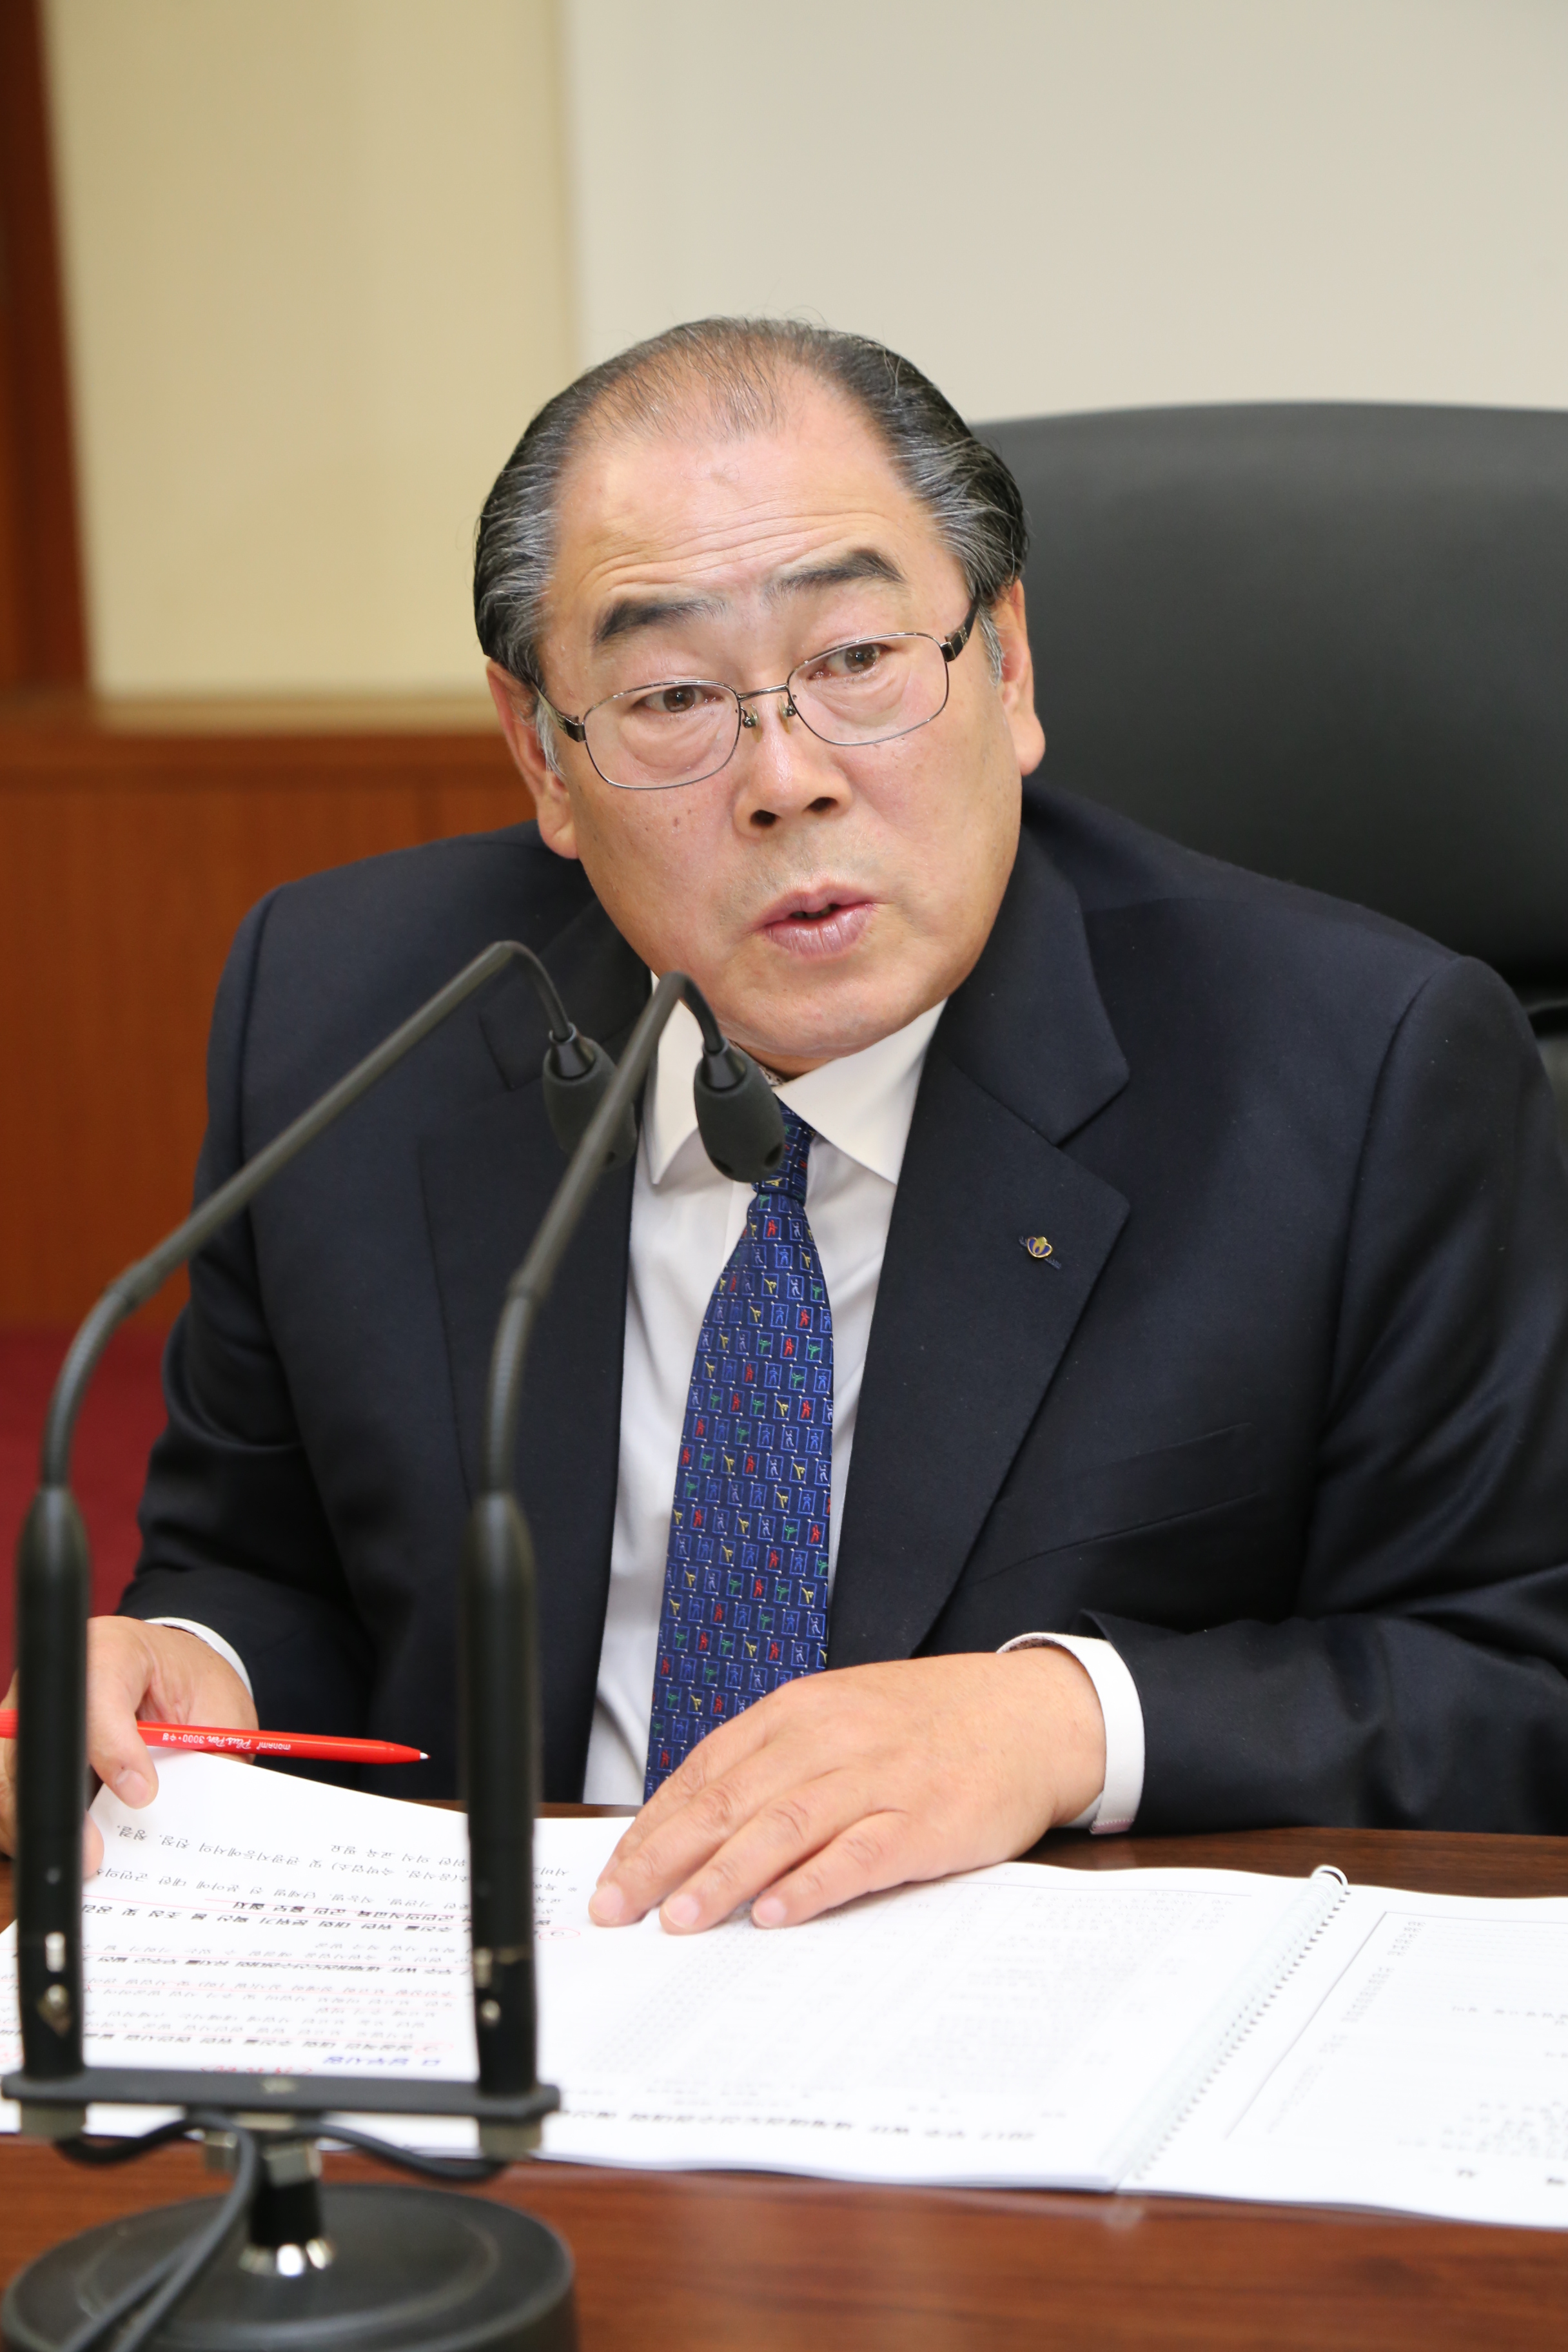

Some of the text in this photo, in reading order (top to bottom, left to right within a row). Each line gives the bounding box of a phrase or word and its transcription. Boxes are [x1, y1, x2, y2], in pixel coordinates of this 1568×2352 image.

[206, 1735, 226, 1747] Pen
[226, 1737, 251, 1749] Plus
[199, 1842, 300, 1866] 관광지등에서의
[330, 1845, 357, 1856] 필요
[364, 1848, 395, 1859] 교육
[309, 1859, 322, 1868] 및
[402, 1854, 431, 1863] 의식
[158, 1876, 186, 1886] 대한
